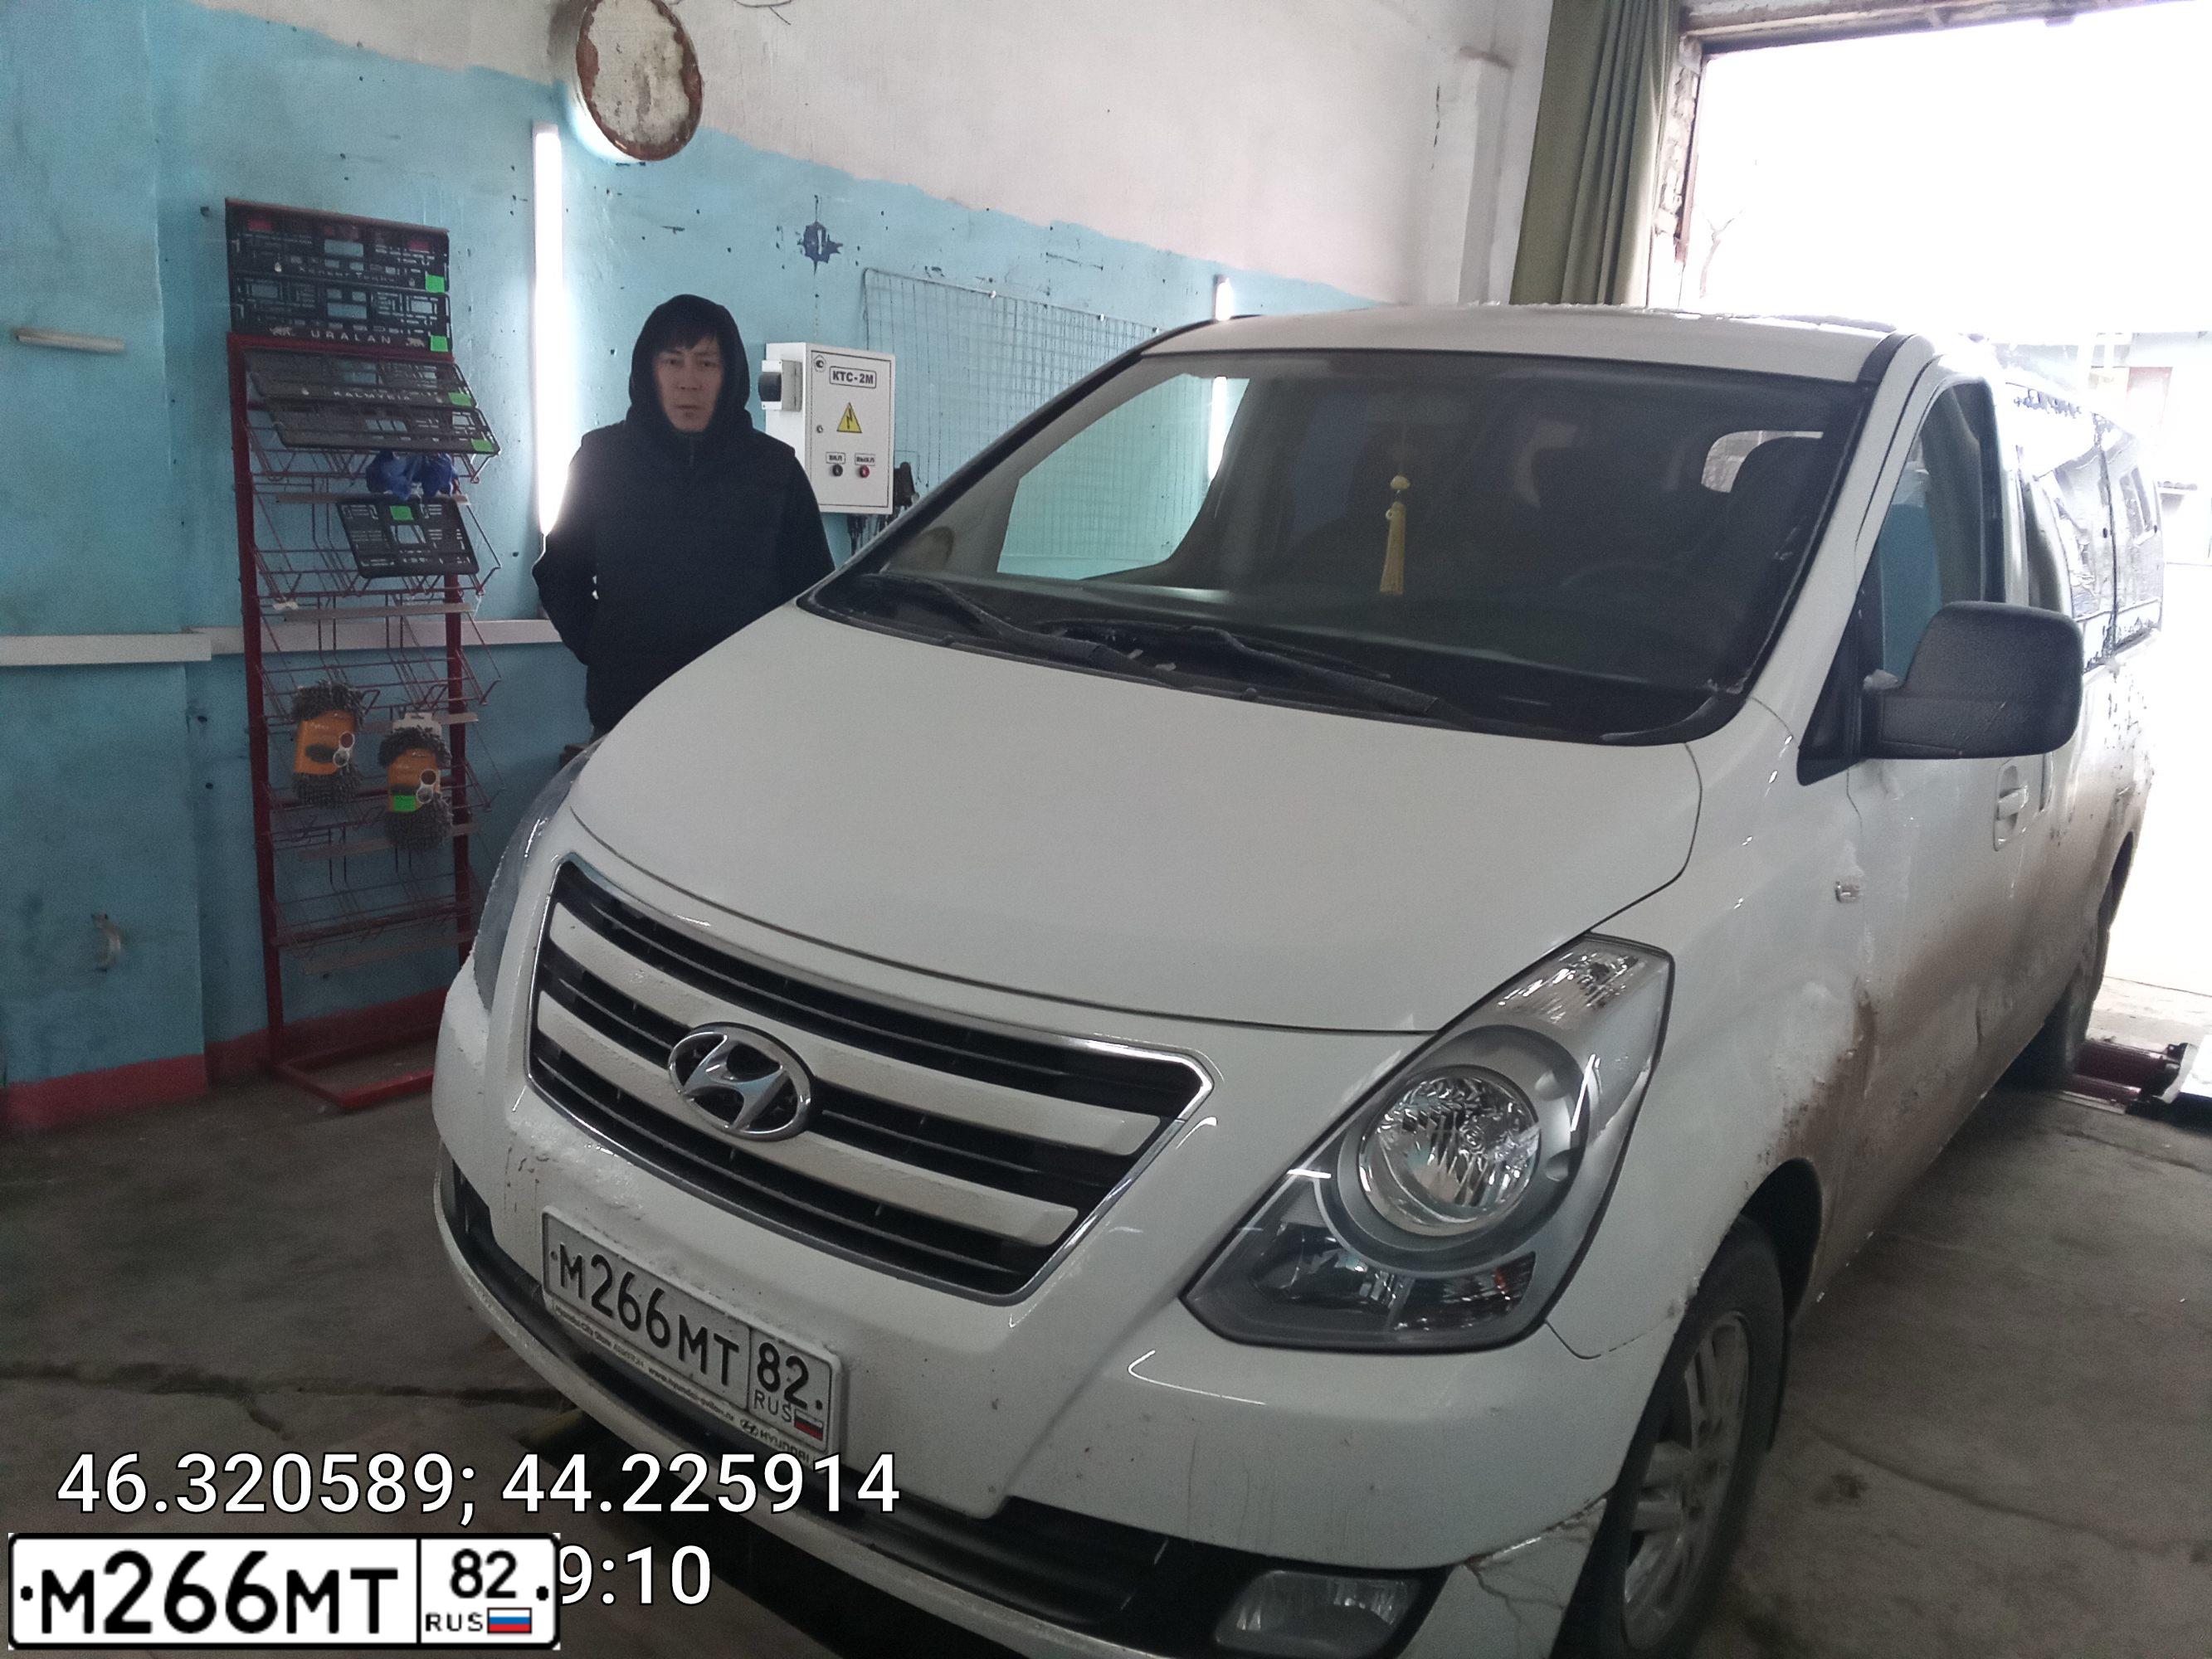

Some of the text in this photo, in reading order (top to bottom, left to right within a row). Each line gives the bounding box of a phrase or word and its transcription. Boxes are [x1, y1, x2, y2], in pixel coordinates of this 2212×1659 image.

[310, 329, 392, 345] URALAN
[757, 1341, 809, 1409] 82
[753, 1389, 792, 1424] RUS
[759, 1429, 811, 1463] HYUNDAI
